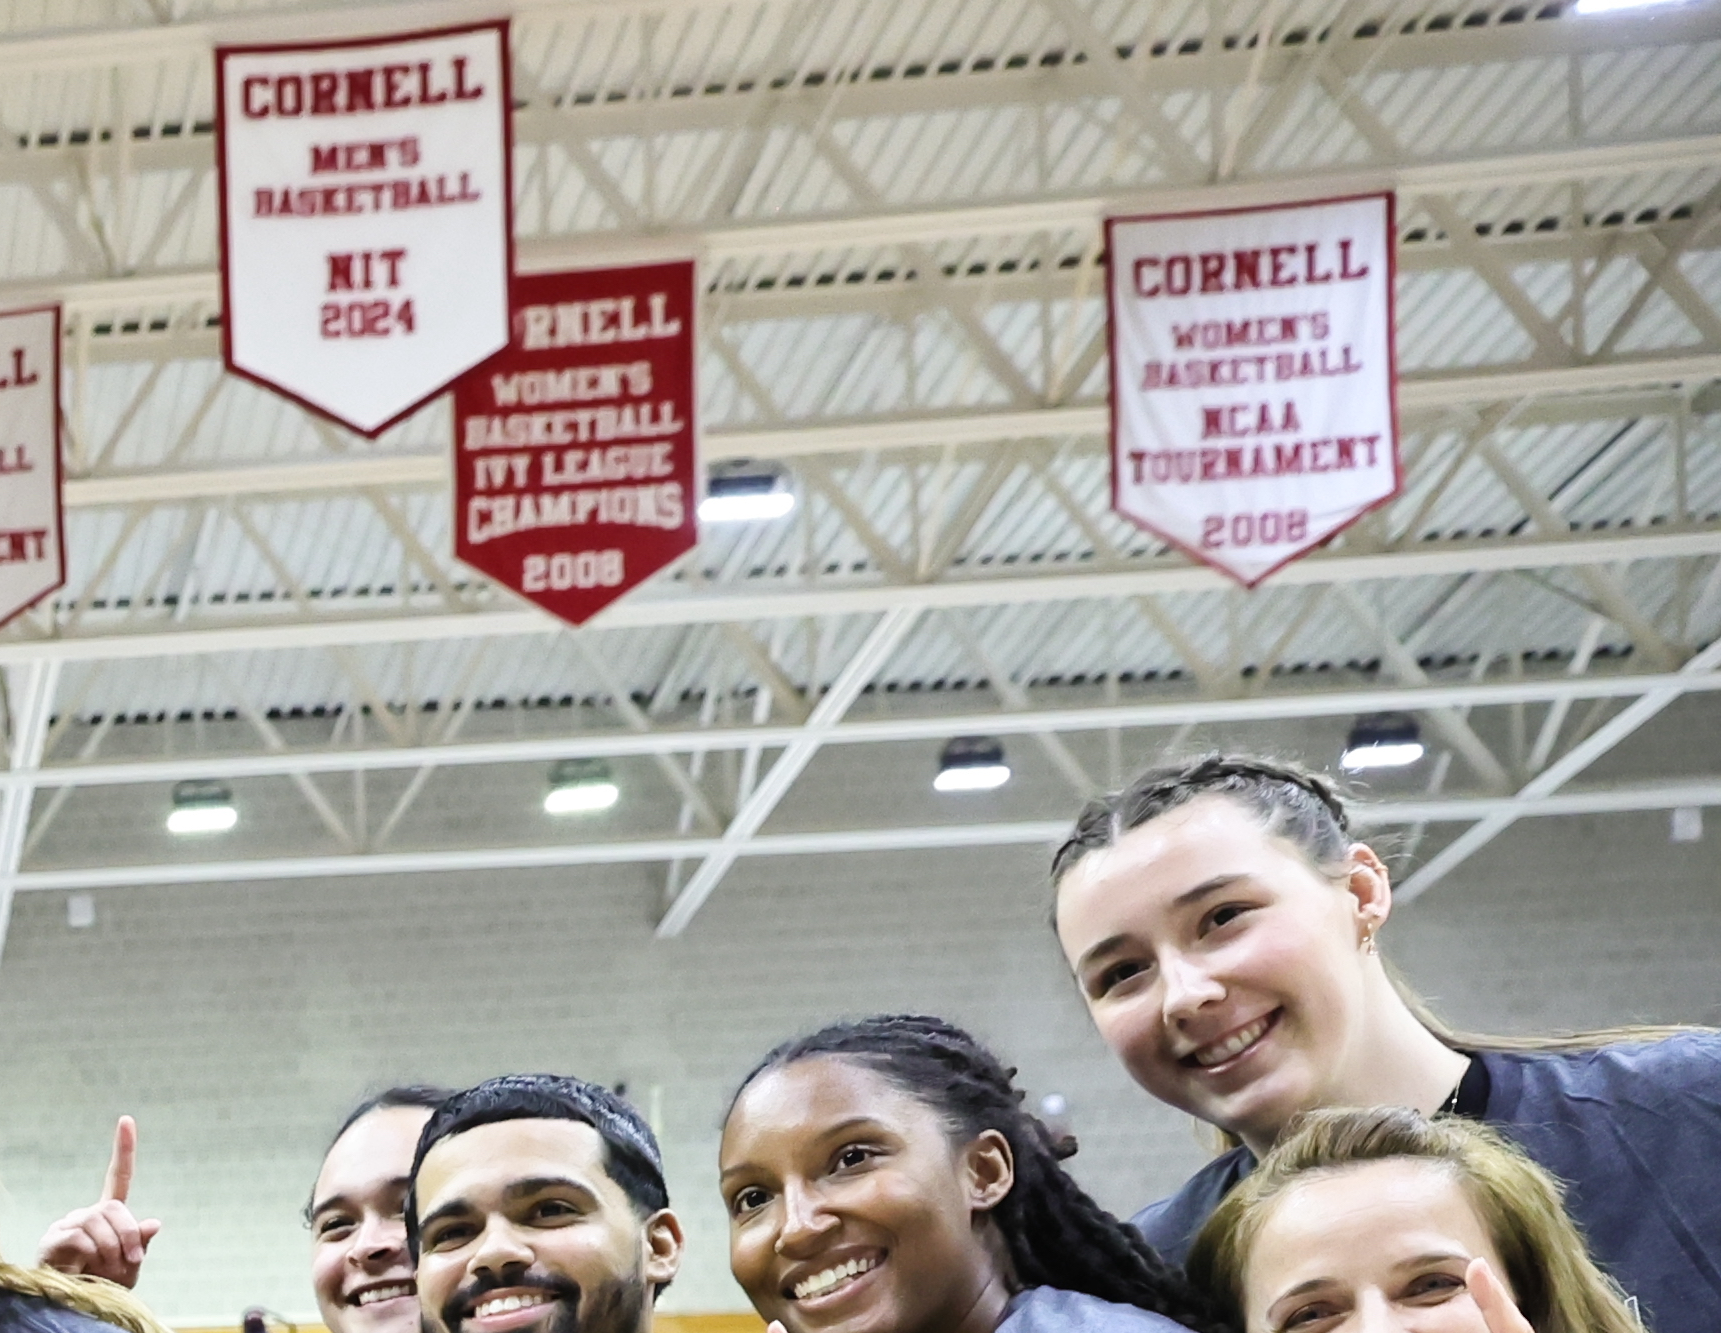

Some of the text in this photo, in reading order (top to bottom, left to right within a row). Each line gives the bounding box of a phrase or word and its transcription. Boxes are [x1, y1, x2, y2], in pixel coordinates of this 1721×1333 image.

[242, 57, 484, 121] CORNELL
[310, 136, 420, 177] MEN'S
[253, 173, 480, 218] BASKETBALL
[326, 248, 407, 292] NIT
[1133, 238, 1370, 298] CORNELL
[319, 298, 417, 339] 2024
[522, 293, 681, 350] RNELL
[1171, 311, 1329, 350] WOMEN'S
[492, 360, 651, 406] WOMEN'S
[1141, 345, 1363, 392] BASKETBALL
[465, 401, 684, 451] BASKETBALL
[1201, 400, 1301, 440] NCAA
[473, 443, 674, 492] IVY LEAGUE
[1126, 433, 1382, 484] TOURNAMENT
[467, 483, 684, 545] CHAMPIONS
[1200, 510, 1309, 549] 2008
[522, 550, 623, 593] 2008
